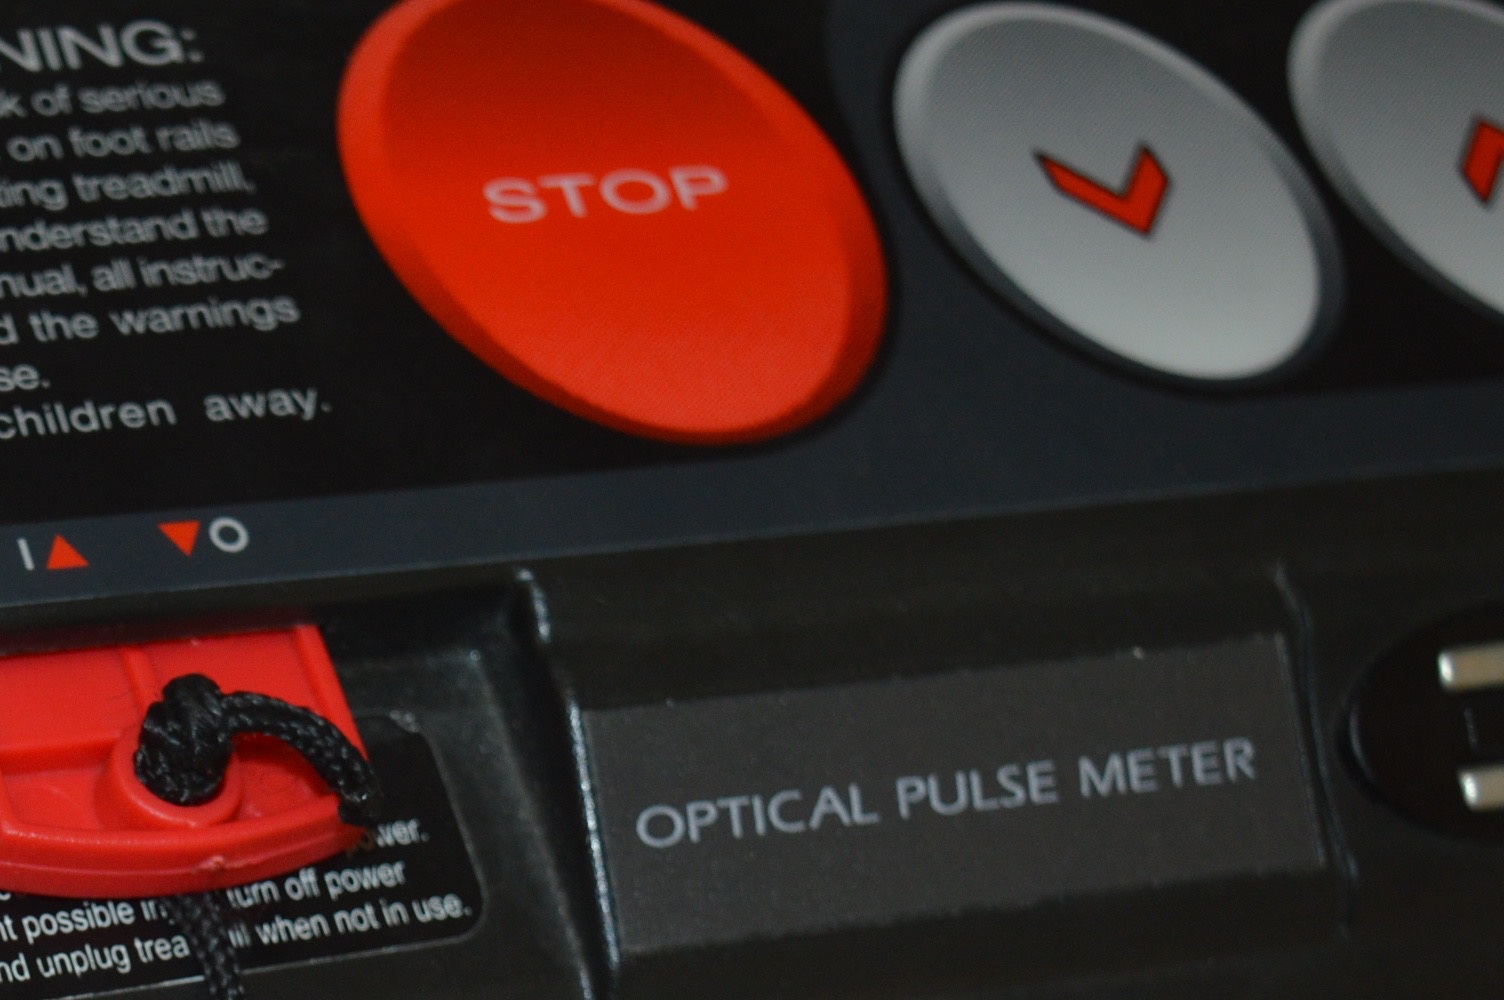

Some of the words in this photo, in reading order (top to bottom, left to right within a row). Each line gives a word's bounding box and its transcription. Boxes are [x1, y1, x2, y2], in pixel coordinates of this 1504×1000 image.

[30, 85, 75, 117] of
[82, 79, 226, 114] serious
[8, 134, 63, 162] on
[69, 126, 152, 158] foot
[157, 118, 238, 153] rails
[74, 161, 256, 203] treadmill,
[482, 164, 729, 224] STOP
[202, 206, 268, 242] the
[91, 258, 138, 291] all
[140, 251, 284, 288] instruc-
[29, 308, 97, 342] the
[108, 295, 300, 336] warnings
[203, 386, 333, 422] away.
[636, 785, 879, 849] OPTICAL
[896, 761, 1058, 820] PULSE
[1079, 736, 1257, 797] METER
[22, 898, 136, 944] possible
[226, 884, 280, 908] turn
[284, 866, 320, 901] off
[324, 859, 407, 900] power
[36, 943, 132, 980] unplug
[256, 911, 330, 947] when
[334, 900, 381, 934] not
[383, 897, 411, 927] in
[413, 891, 473, 924] use.
